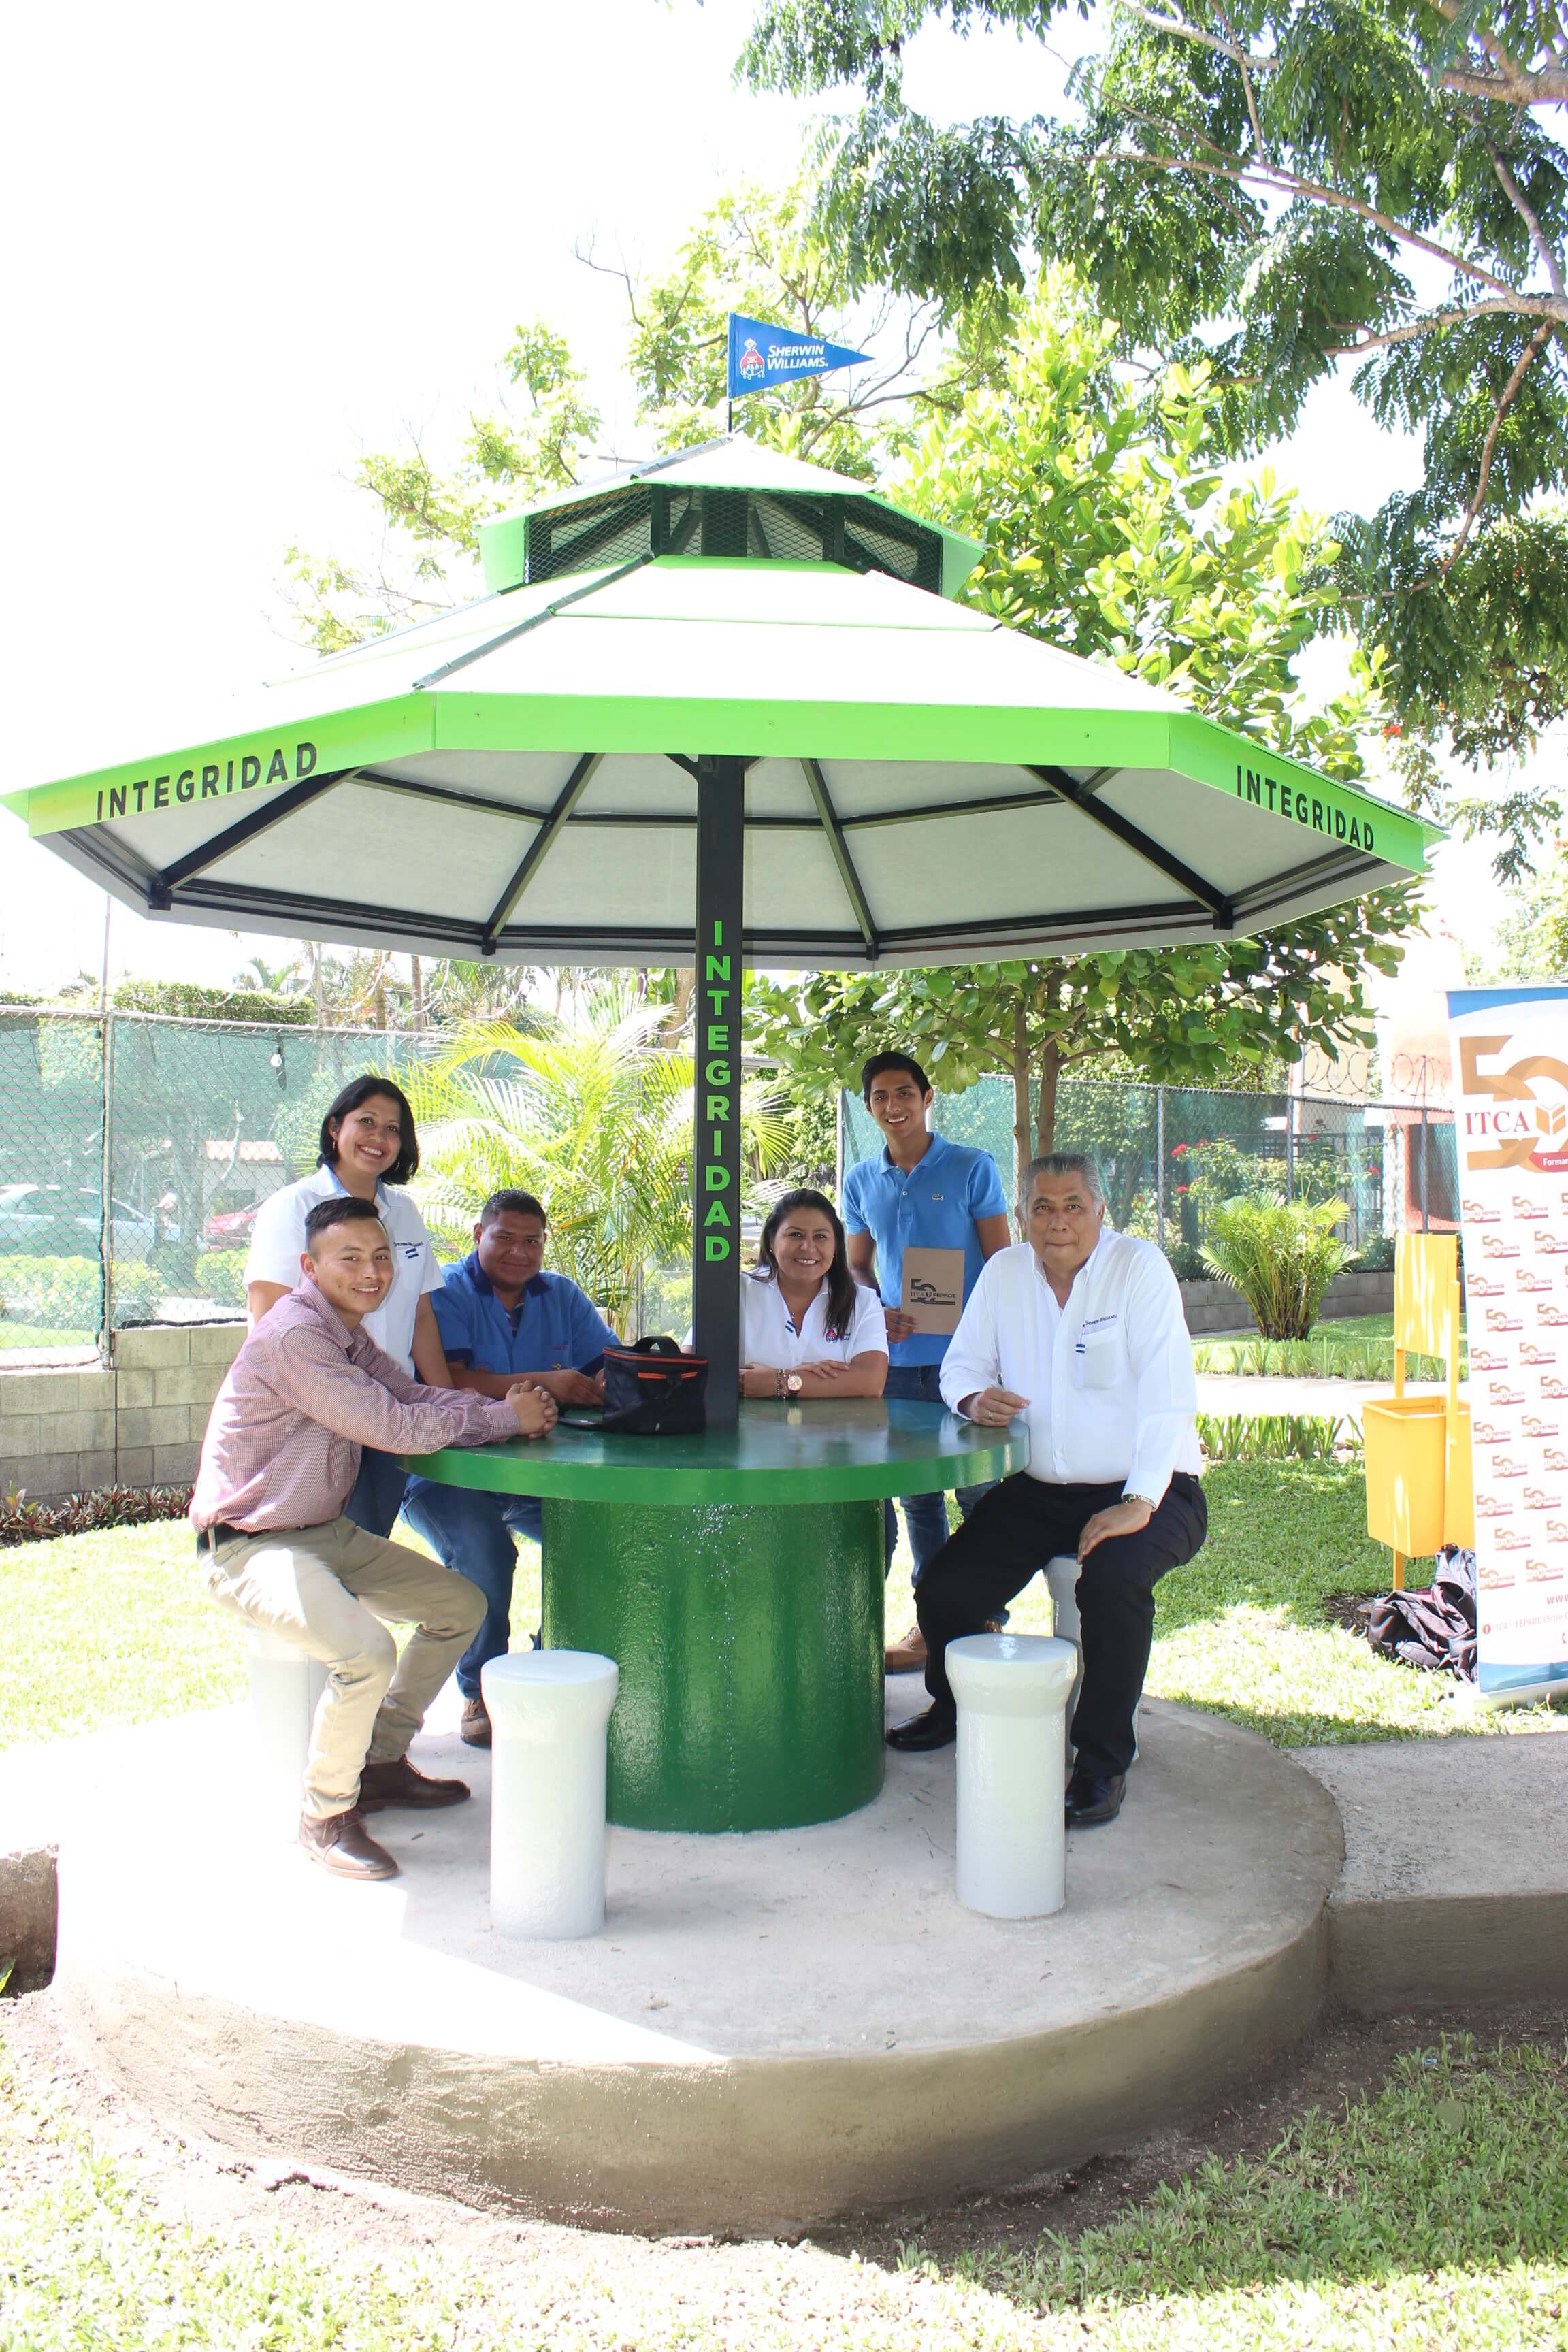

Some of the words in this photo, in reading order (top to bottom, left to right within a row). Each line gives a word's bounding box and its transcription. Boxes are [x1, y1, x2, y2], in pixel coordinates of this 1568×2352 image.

[768, 344, 824, 357] SHERWIN
[97, 742, 317, 821] INTEGRIDAD
[1237, 765, 1374, 851] INTEGRIDAD
[704, 921, 730, 1261] INTEGRIDAD
[1465, 1111, 1531, 1134] ITCA
